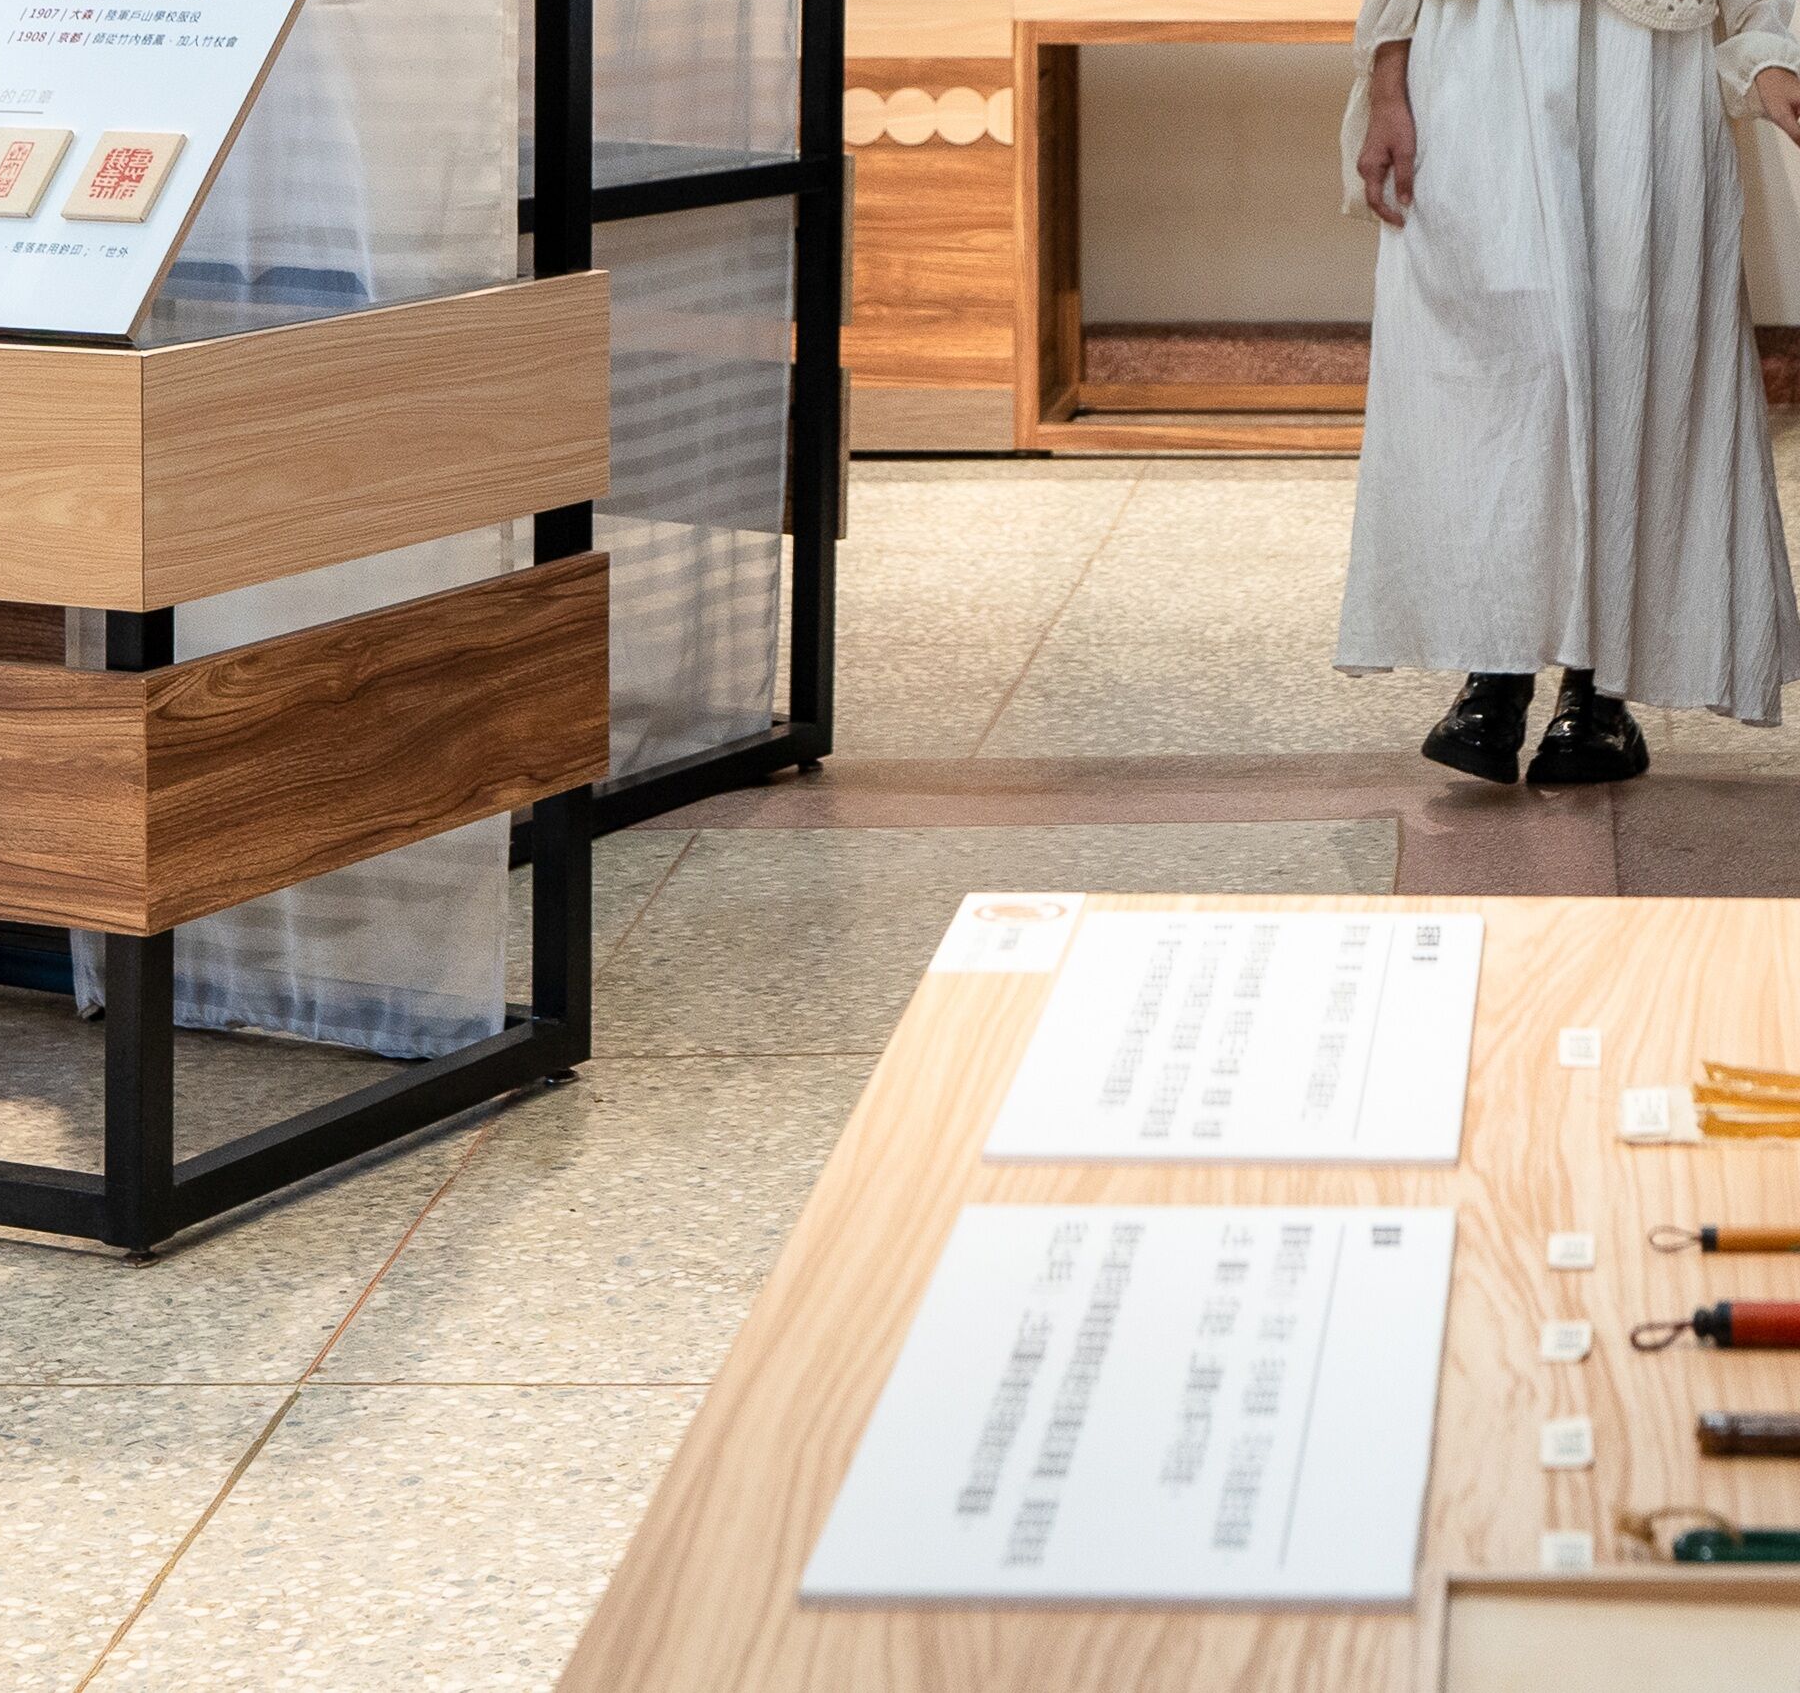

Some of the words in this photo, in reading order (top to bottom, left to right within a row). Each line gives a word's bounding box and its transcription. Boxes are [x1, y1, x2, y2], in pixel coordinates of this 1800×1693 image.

[28, 8, 59, 19] 1907
[70, 9, 95, 20] 大森
[16, 31, 47, 42] 1908
[57, 32, 83, 44] 京都
